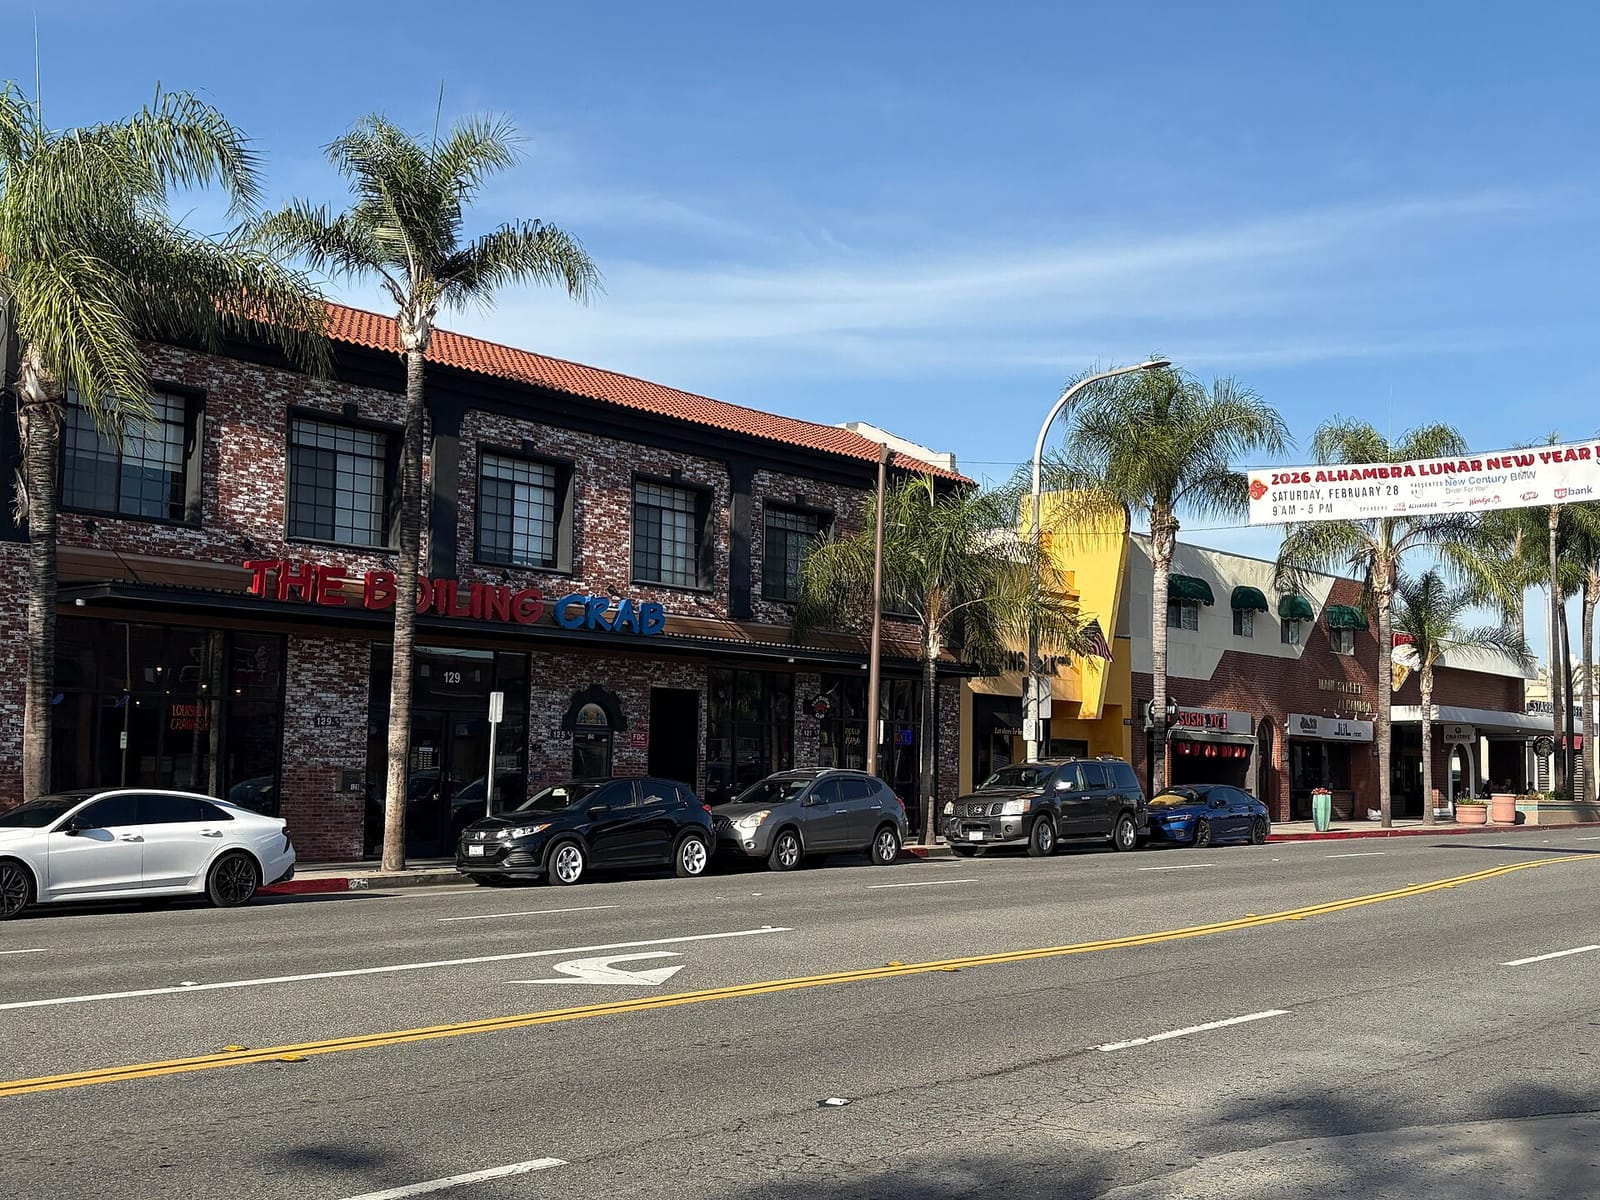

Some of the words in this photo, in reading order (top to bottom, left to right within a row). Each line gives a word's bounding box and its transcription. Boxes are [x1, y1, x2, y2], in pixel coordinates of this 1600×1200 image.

[1271, 471, 1311, 486] 2026
[1315, 465, 1416, 483] ALHAMBRA
[1418, 460, 1482, 476] LUNAR
[1487, 453, 1535, 471] NEW
[1538, 447, 1591, 465] YEAR
[1445, 478, 1465, 487] New
[1468, 475, 1508, 486] Century
[1510, 470, 1536, 481] BMW
[1272, 489, 1324, 503] SATURDAY,
[1329, 486, 1381, 499] FEBRUARY
[1386, 485, 1399, 496] 28
[1568, 485, 1593, 496] bank
[1272, 506, 1278, 516] 9
[1281, 505, 1296, 515] AM
[1308, 504, 1314, 514] 5
[1319, 503, 1333, 513] PM
[243, 560, 347, 607] THE
[364, 571, 544, 624] BOILING
[553, 593, 666, 636] CRAB
[443, 672, 460, 683] 129
[317, 717, 332, 726] 129
[633, 733, 646, 741] FDC
